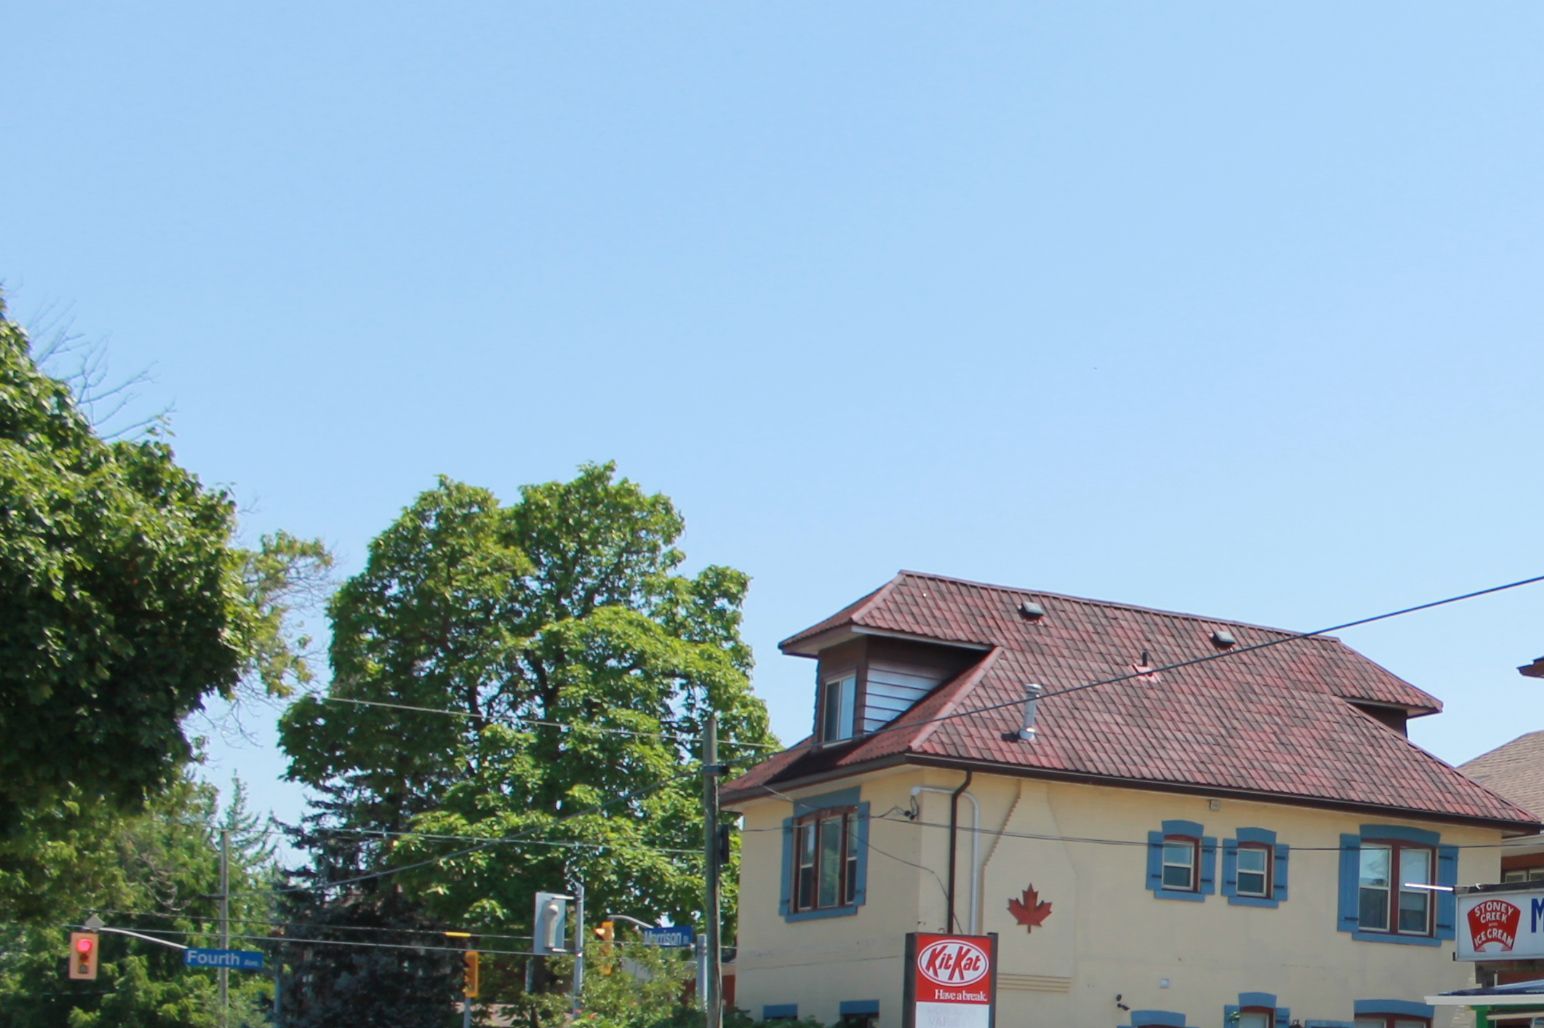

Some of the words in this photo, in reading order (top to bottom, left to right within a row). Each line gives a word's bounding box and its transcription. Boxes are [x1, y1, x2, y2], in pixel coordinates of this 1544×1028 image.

[1474, 901, 1514, 917] STONEY
[1480, 912, 1507, 924] CREEK
[1474, 931, 1487, 948] ICE
[1487, 928, 1514, 948] CREAM
[187, 950, 240, 965] Fourth
[925, 945, 981, 981] KitKat
[935, 989, 956, 1000] Have
